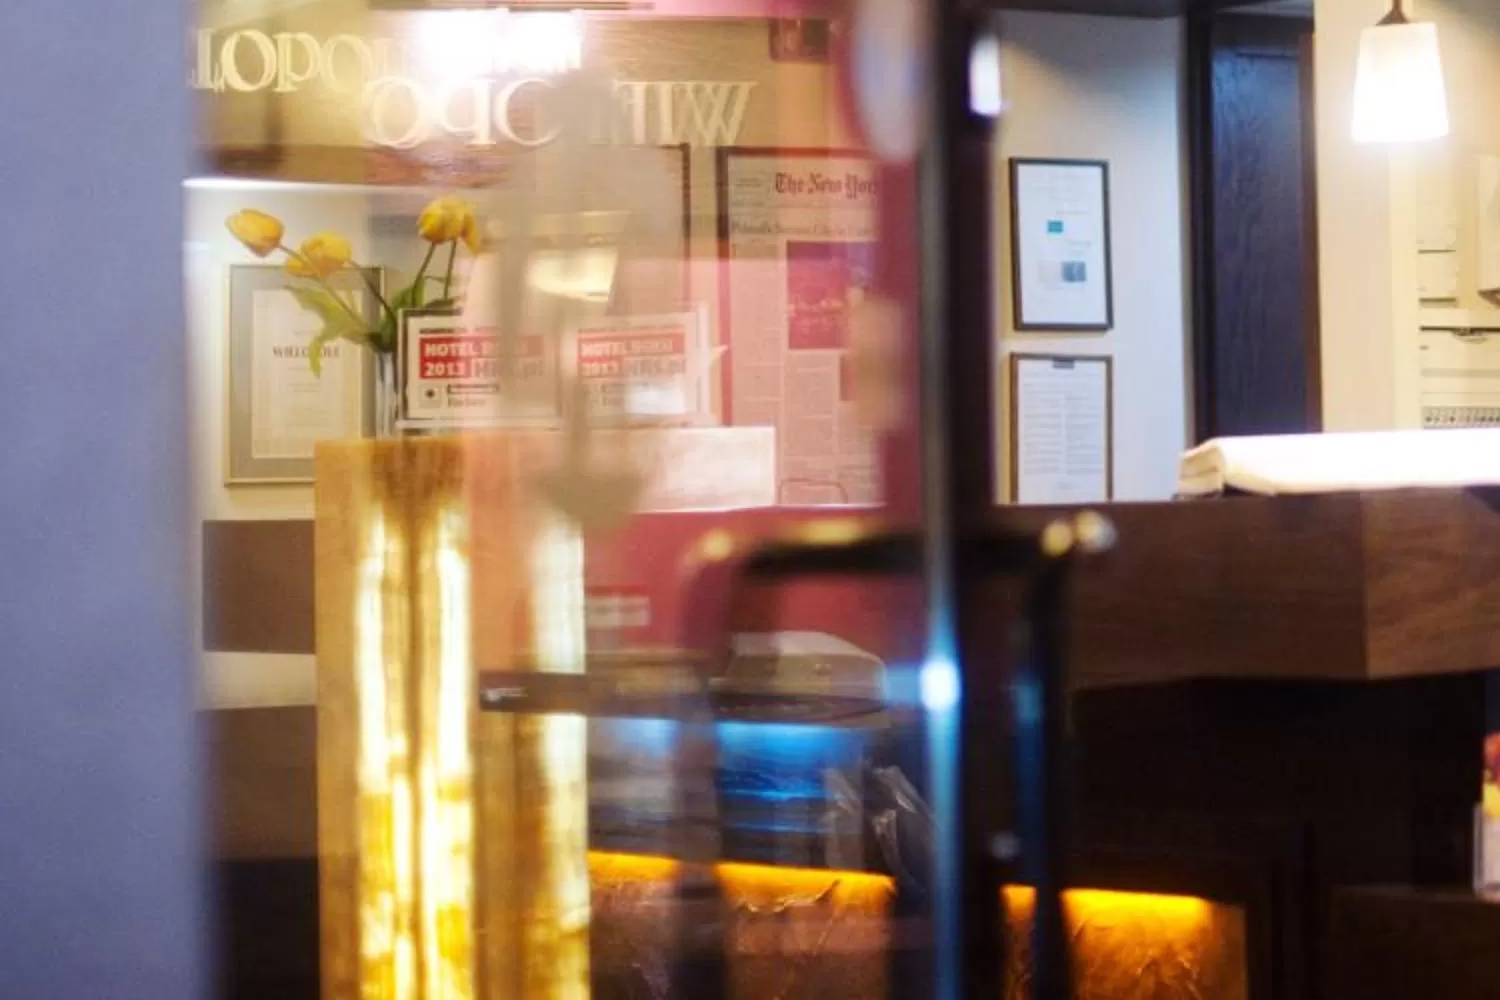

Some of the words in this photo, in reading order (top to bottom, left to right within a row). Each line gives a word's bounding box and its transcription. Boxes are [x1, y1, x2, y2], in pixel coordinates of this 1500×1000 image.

[775, 171, 805, 196] The
[272, 345, 341, 359] WELCME
[424, 341, 481, 357] HOTEL
